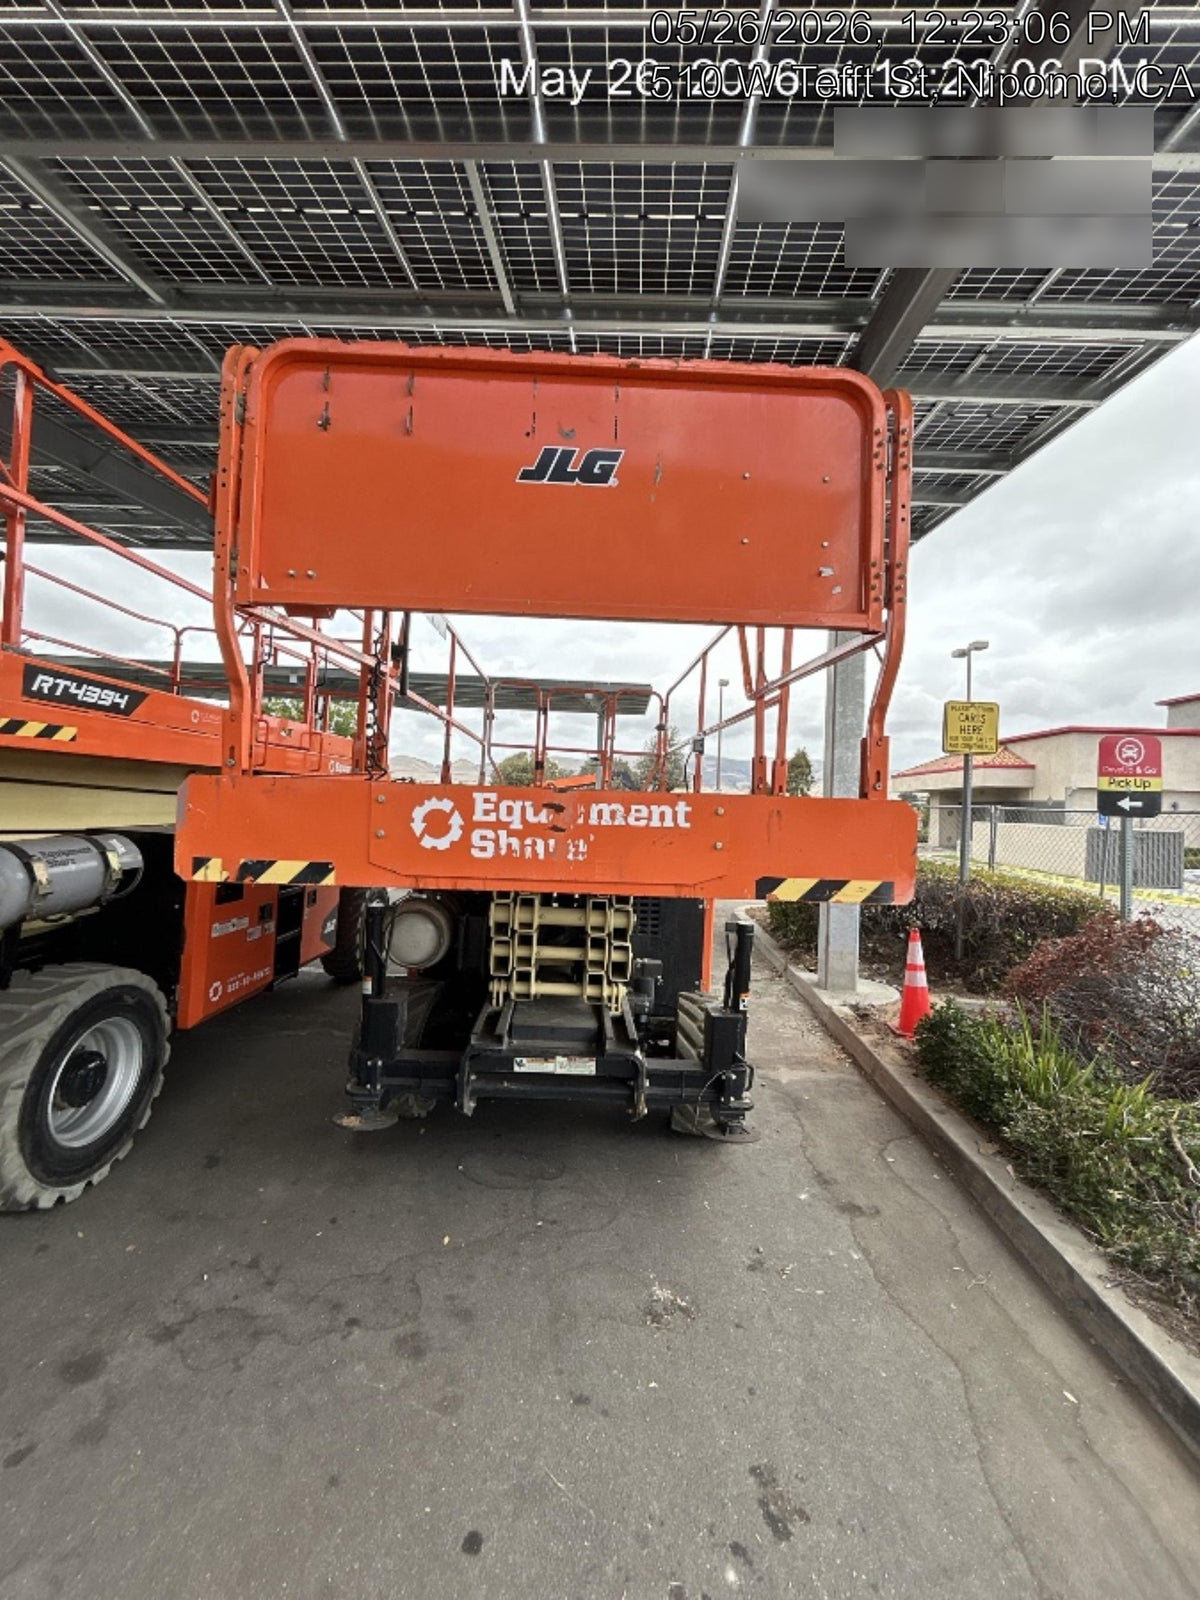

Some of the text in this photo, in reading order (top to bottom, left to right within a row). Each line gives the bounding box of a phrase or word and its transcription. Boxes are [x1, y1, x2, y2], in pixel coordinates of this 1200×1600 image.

[515, 446, 625, 487] JLG
[31, 673, 129, 709] RT4394
[959, 725, 984, 735] HERE
[1144, 766, 1158, 775] Go
[1108, 778, 1152, 790] Pick Up
[472, 792, 692, 829] Equment
